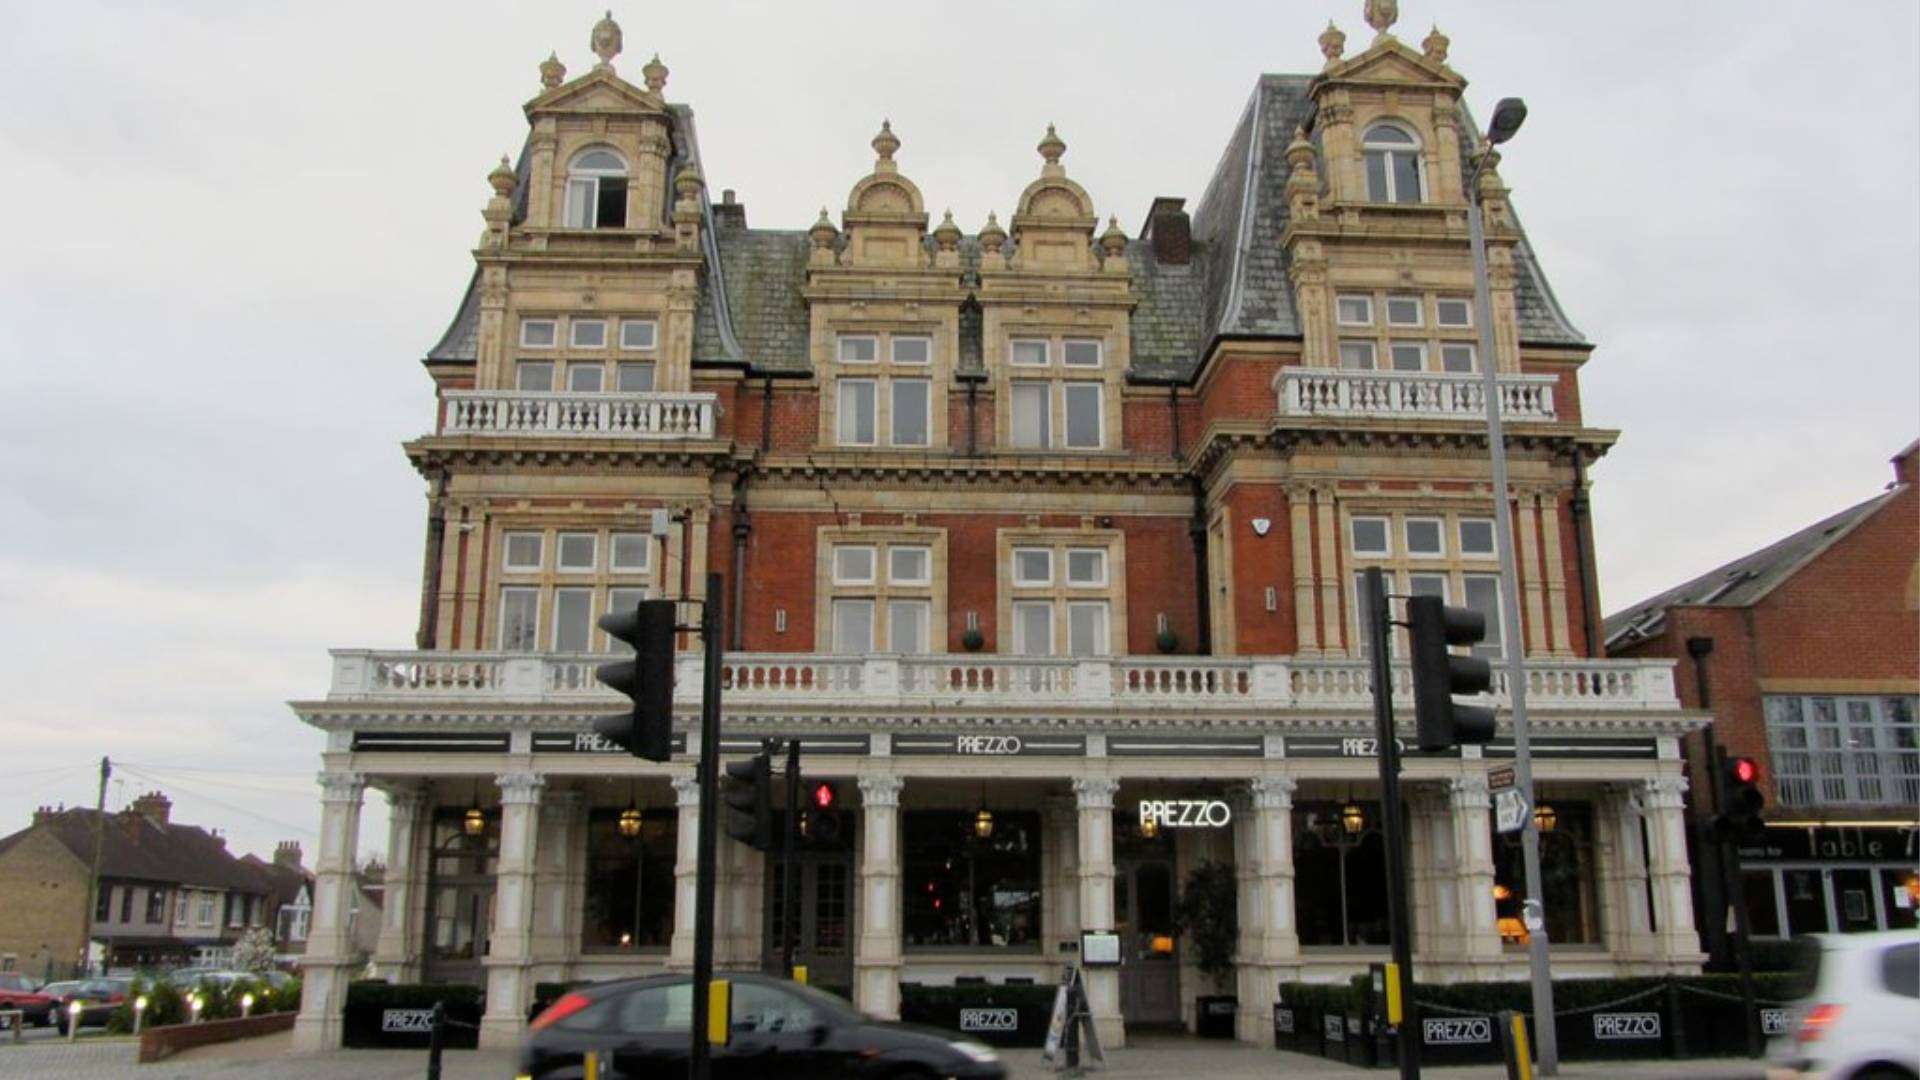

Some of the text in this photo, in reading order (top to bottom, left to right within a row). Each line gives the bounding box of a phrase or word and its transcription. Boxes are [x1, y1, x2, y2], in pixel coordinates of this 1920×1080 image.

[575, 733, 626, 751] PREZ
[958, 735, 1021, 754] PREZZO
[1139, 800, 1230, 827] PREZZO
[963, 1012, 1014, 1028] PREZZO
[1598, 1017, 1656, 1035] PREZZO
[1427, 1021, 1487, 1041] PREZZO
